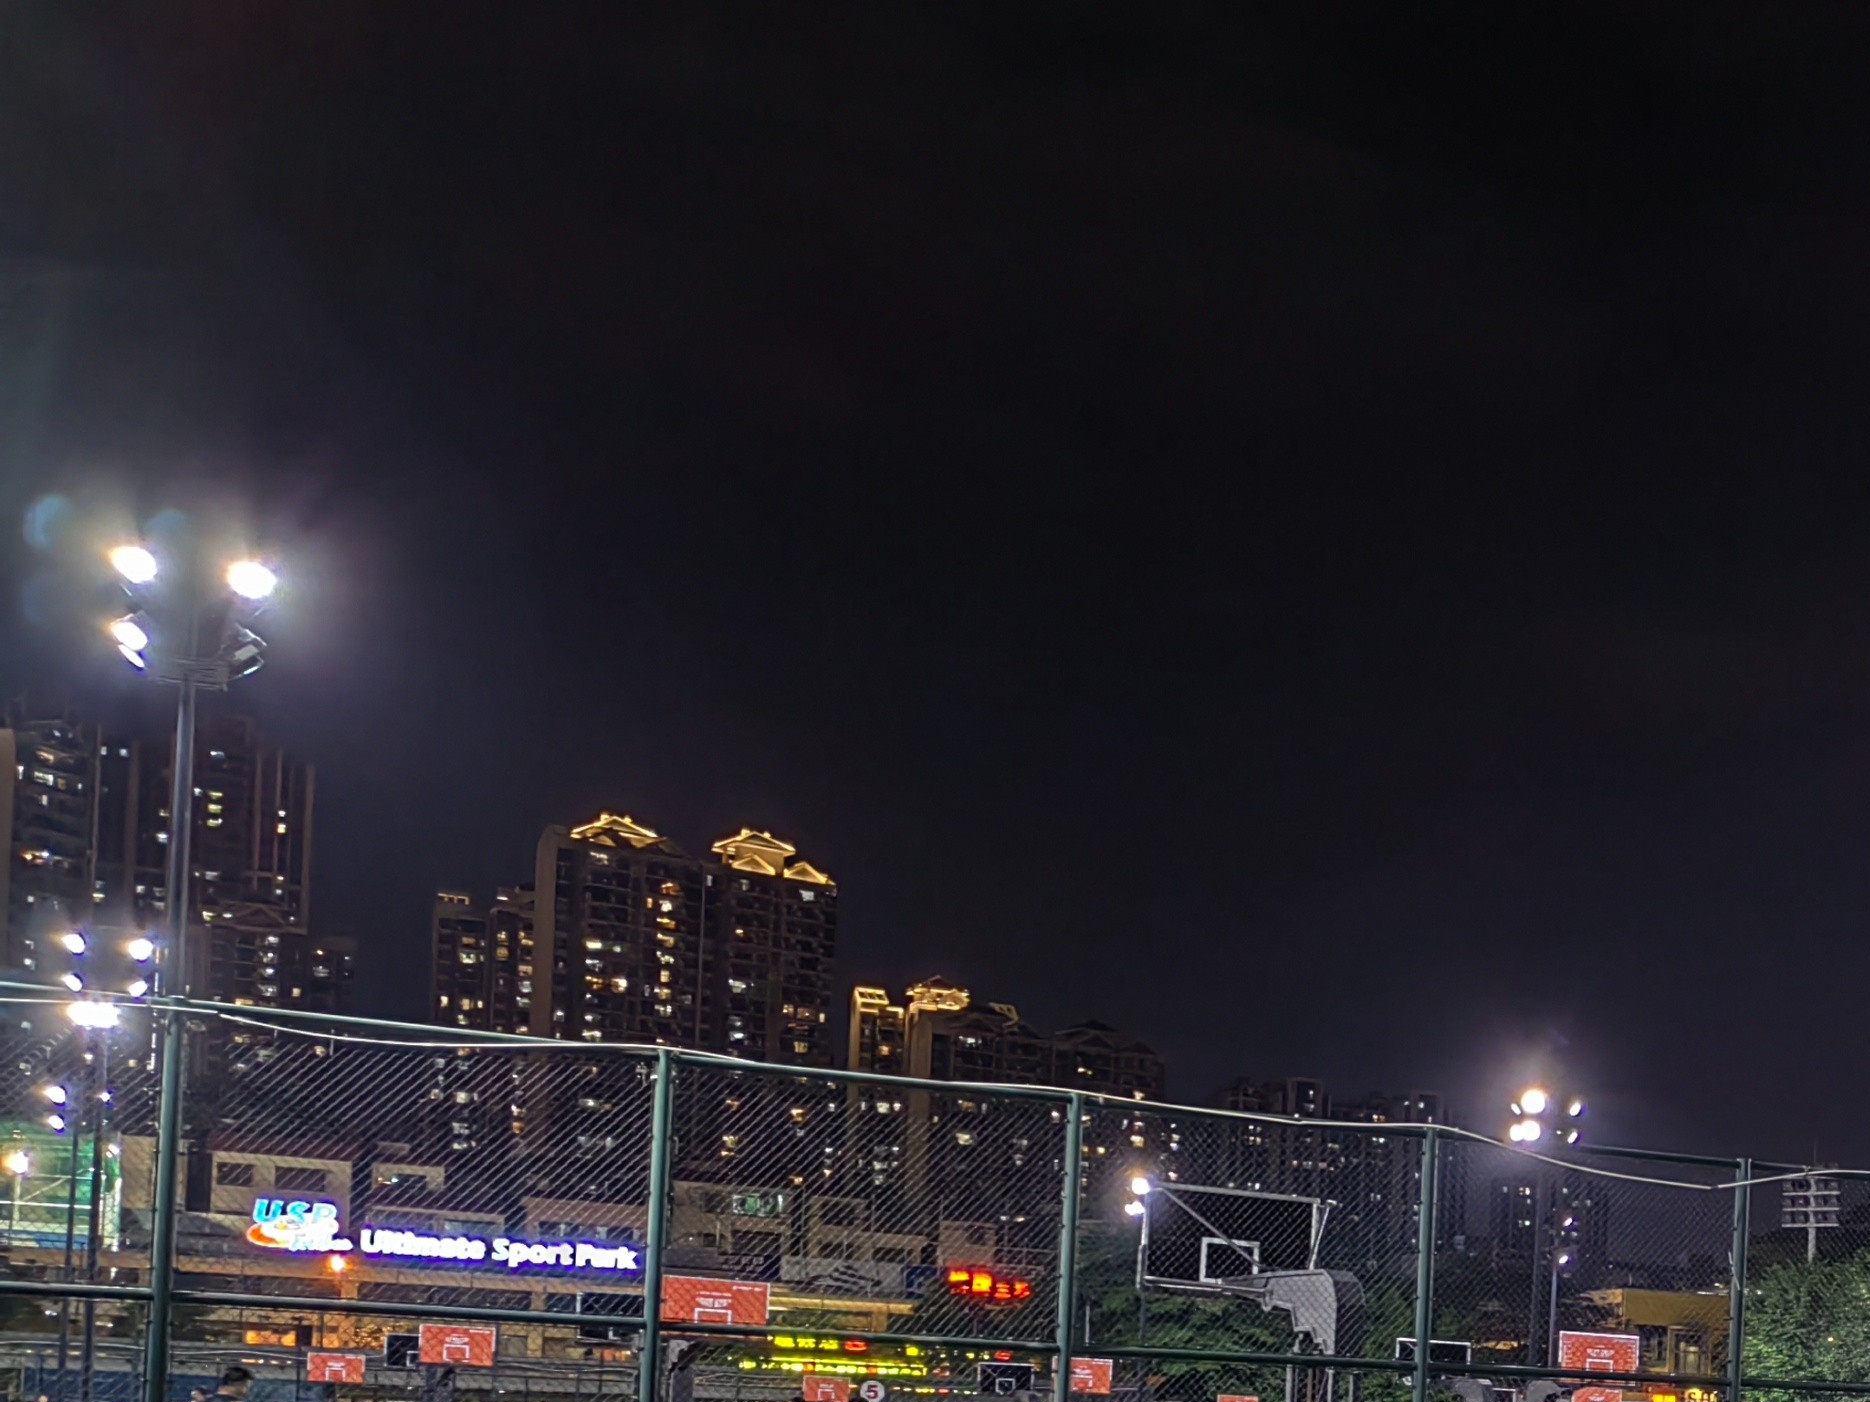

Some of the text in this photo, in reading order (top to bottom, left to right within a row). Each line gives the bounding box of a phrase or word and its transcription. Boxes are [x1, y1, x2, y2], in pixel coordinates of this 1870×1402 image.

[253, 1199, 337, 1224] USP
[360, 1229, 486, 1260] Ultimate
[491, 1238, 574, 1268] Sport
[575, 1243, 638, 1270] Park
[865, 1384, 879, 1400] 5
